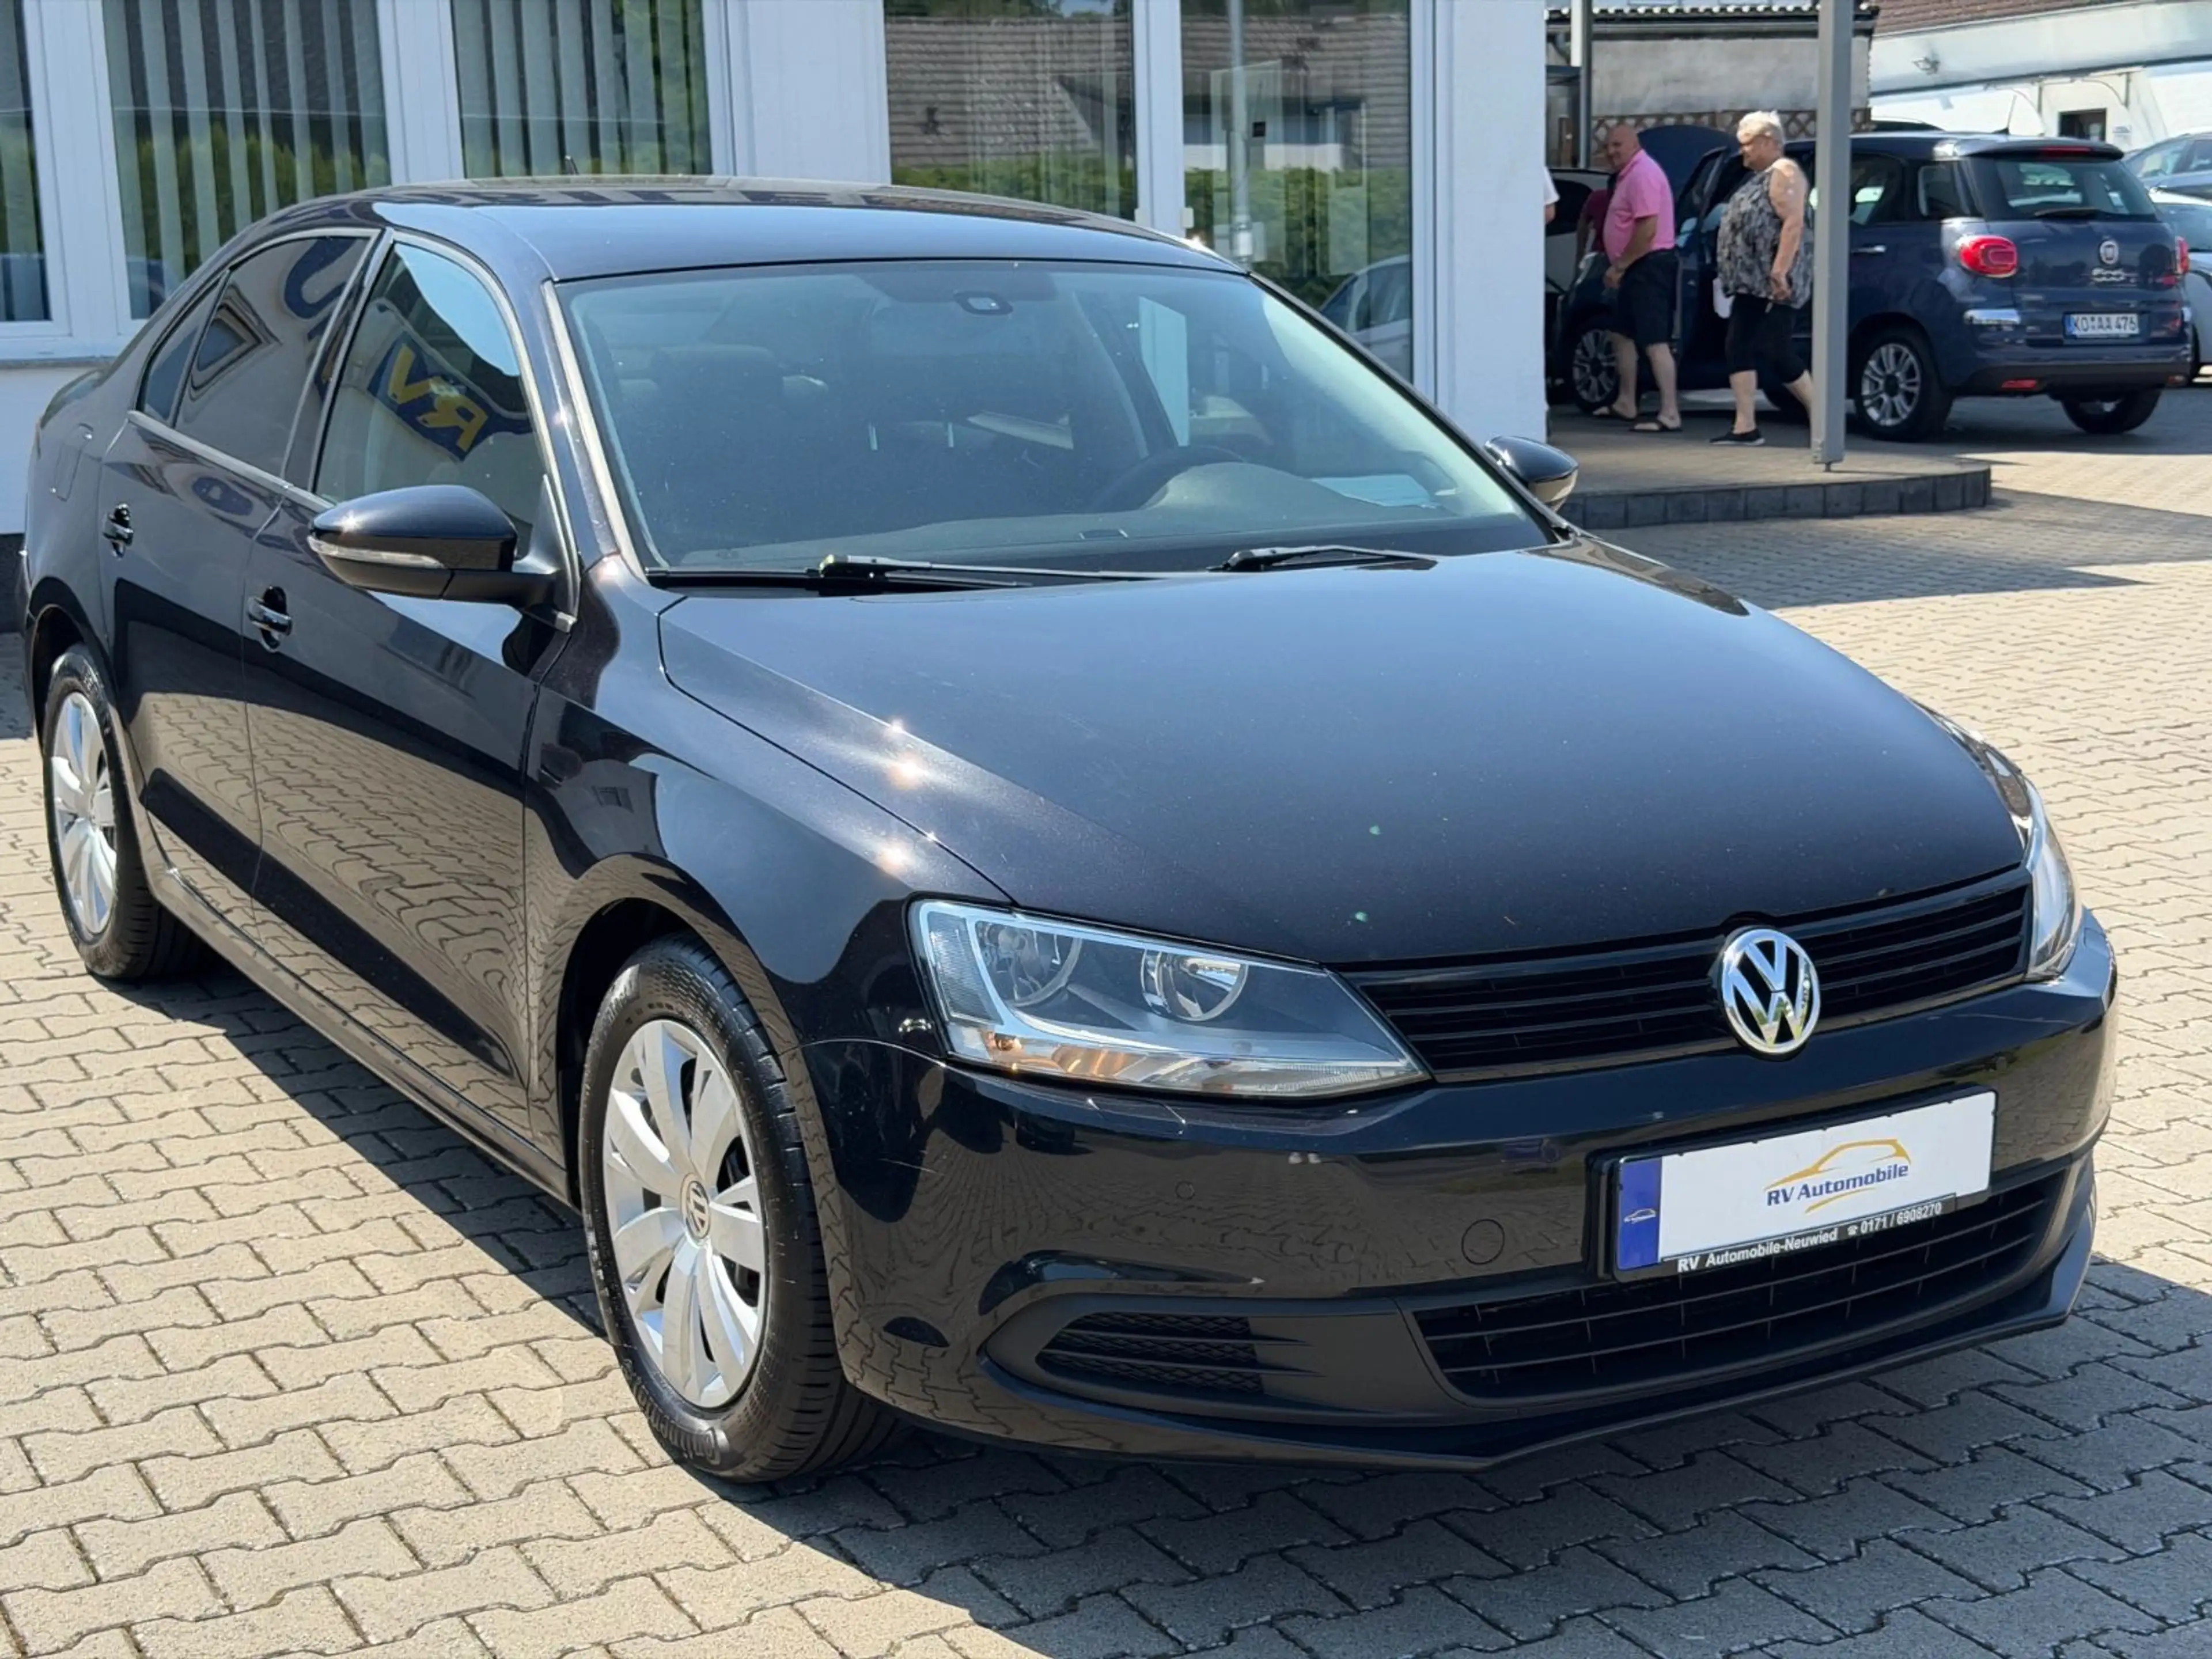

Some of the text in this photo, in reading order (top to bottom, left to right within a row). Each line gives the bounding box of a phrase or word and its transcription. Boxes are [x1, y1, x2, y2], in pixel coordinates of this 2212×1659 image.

[1766, 1163, 1909, 1206] RV Automobile
[1677, 1255, 1701, 1273] RV
[1705, 1228, 1838, 1267] Automobile-Neuwied
